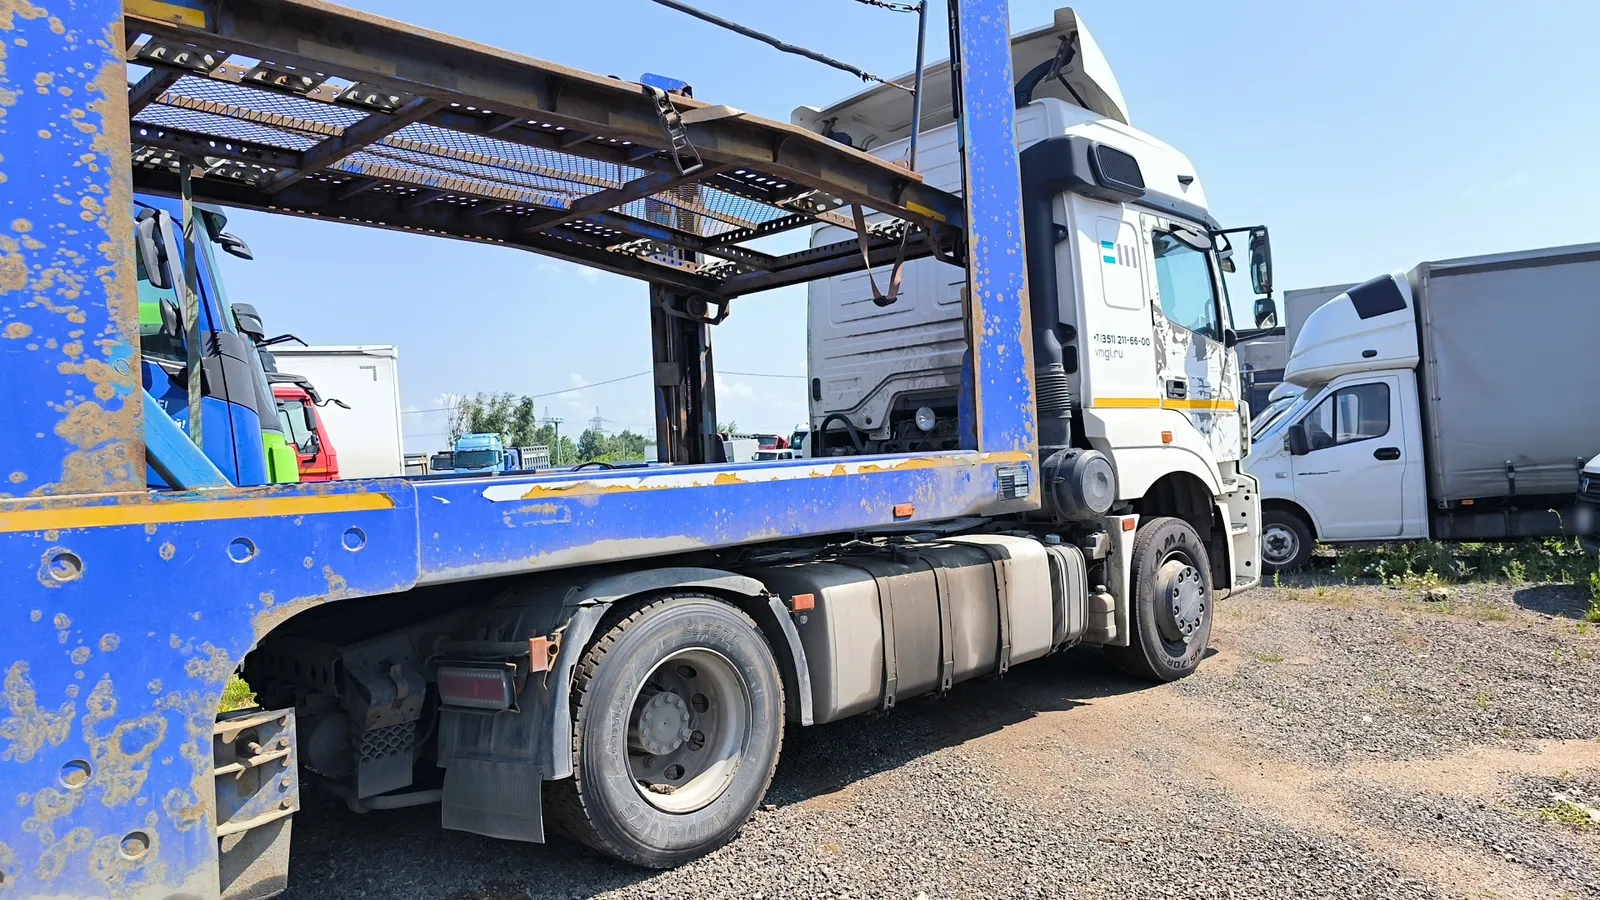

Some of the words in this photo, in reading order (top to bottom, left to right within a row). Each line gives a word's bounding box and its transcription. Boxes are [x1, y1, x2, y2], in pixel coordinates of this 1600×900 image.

[1100, 334, 1116, 345] (351)
[1117, 335, 1151, 346] 211-66-00
[1095, 347, 1124, 361] vmgl.ru
